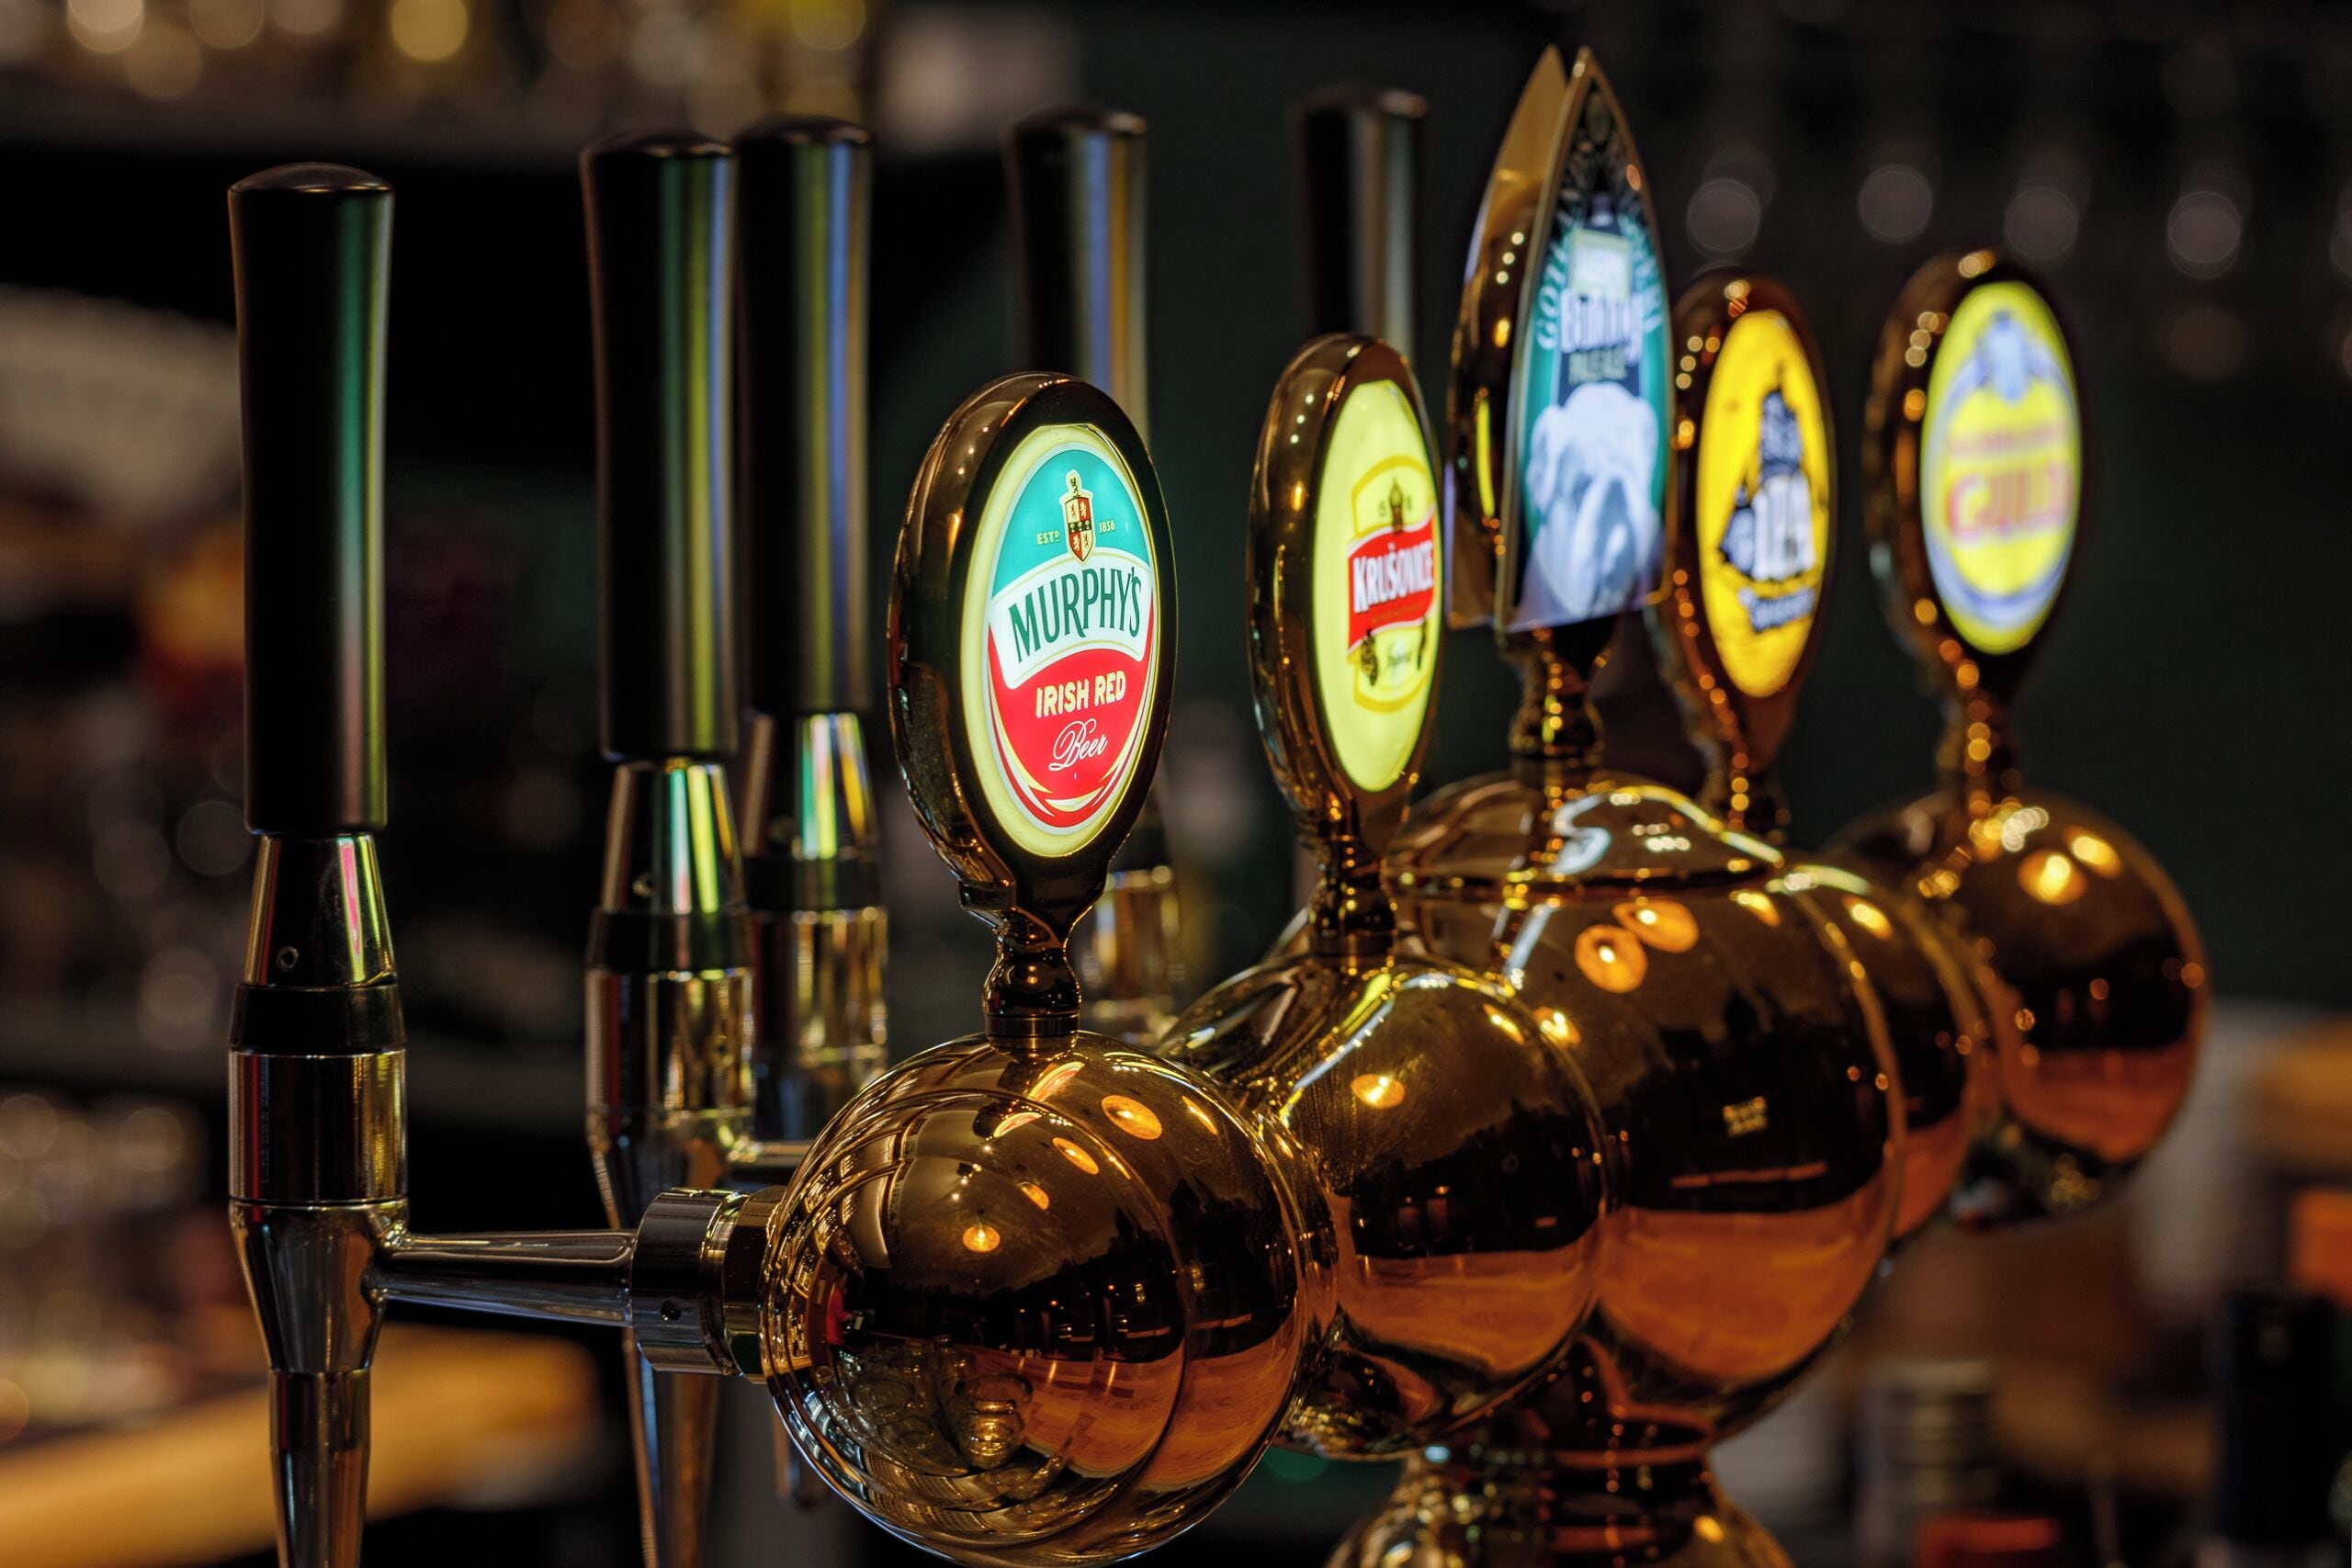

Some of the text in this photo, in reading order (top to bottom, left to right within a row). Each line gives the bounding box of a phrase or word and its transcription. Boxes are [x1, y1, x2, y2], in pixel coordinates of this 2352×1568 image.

[1099, 519, 1115, 534] 1856
[1008, 566, 1142, 663] MURPHY'S
[1035, 670, 1127, 718] IRISH RED
[1048, 717, 1109, 772] Beer
